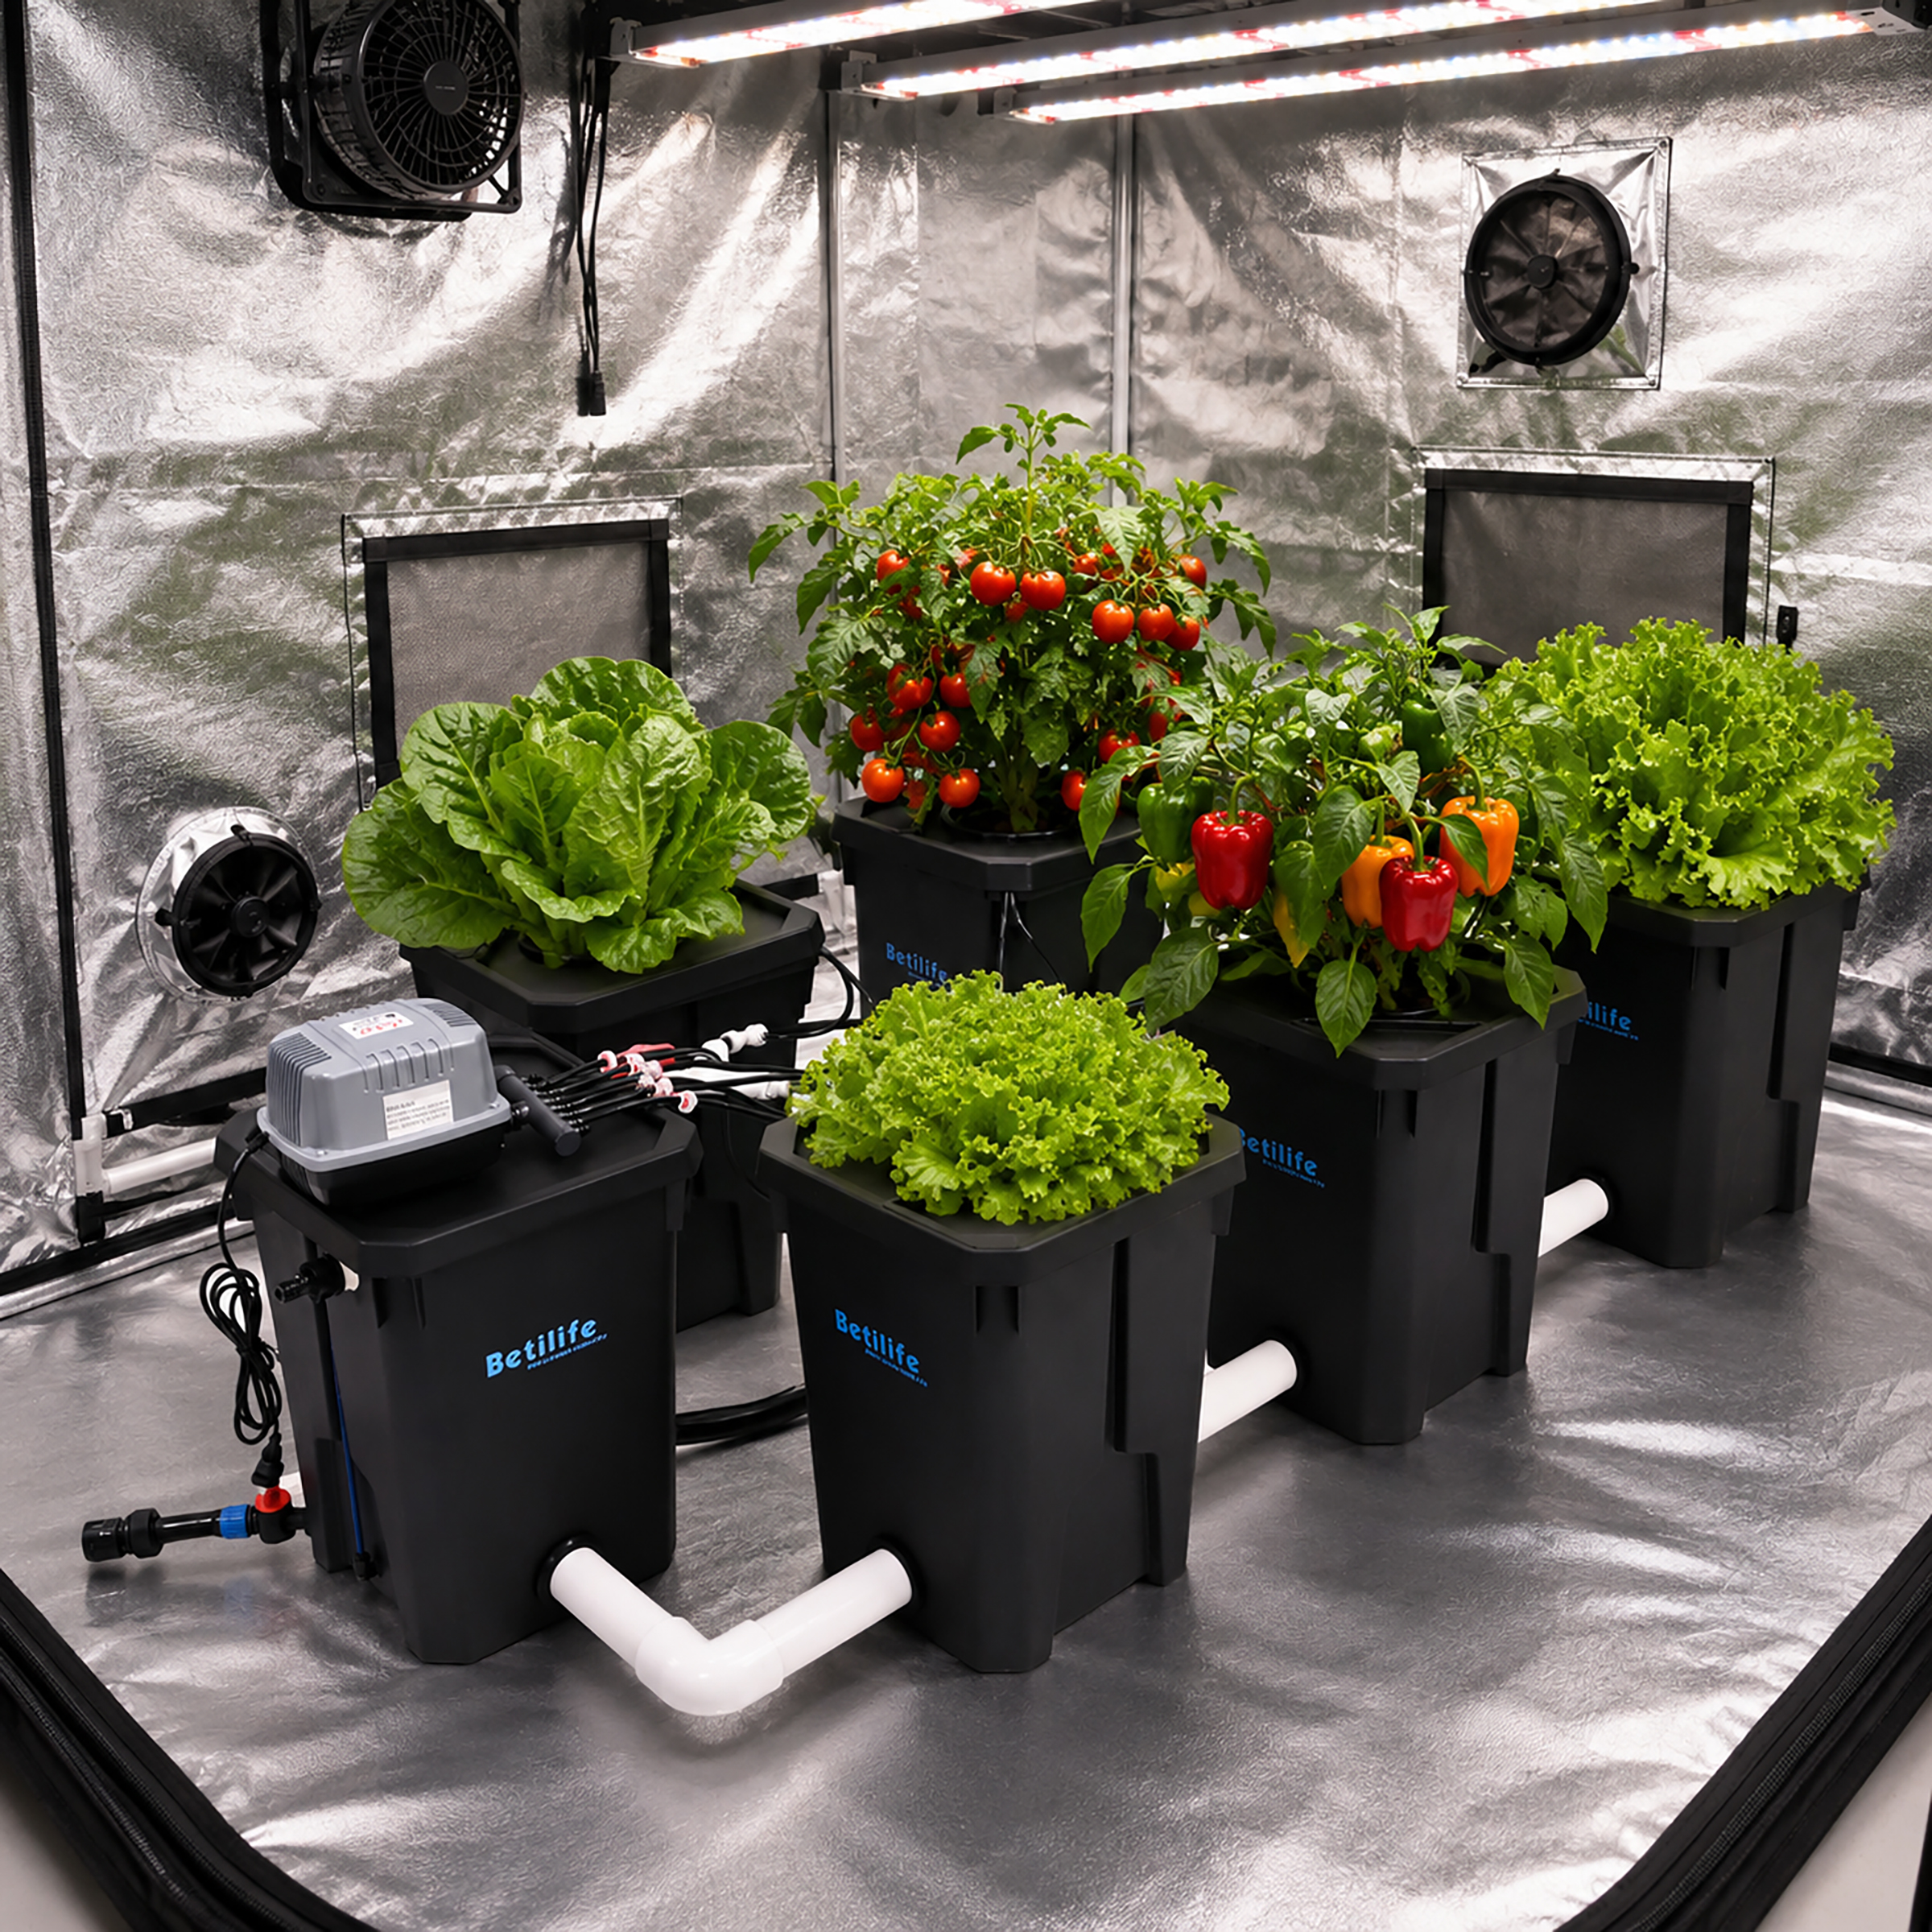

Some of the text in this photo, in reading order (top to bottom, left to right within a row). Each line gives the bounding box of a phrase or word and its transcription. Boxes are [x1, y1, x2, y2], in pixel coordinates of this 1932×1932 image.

[886, 942, 948, 983] Betilife
[1587, 1001, 1632, 1031] ilife
[485, 1319, 597, 1378] Betilife
[834, 1308, 920, 1374] Betilife
